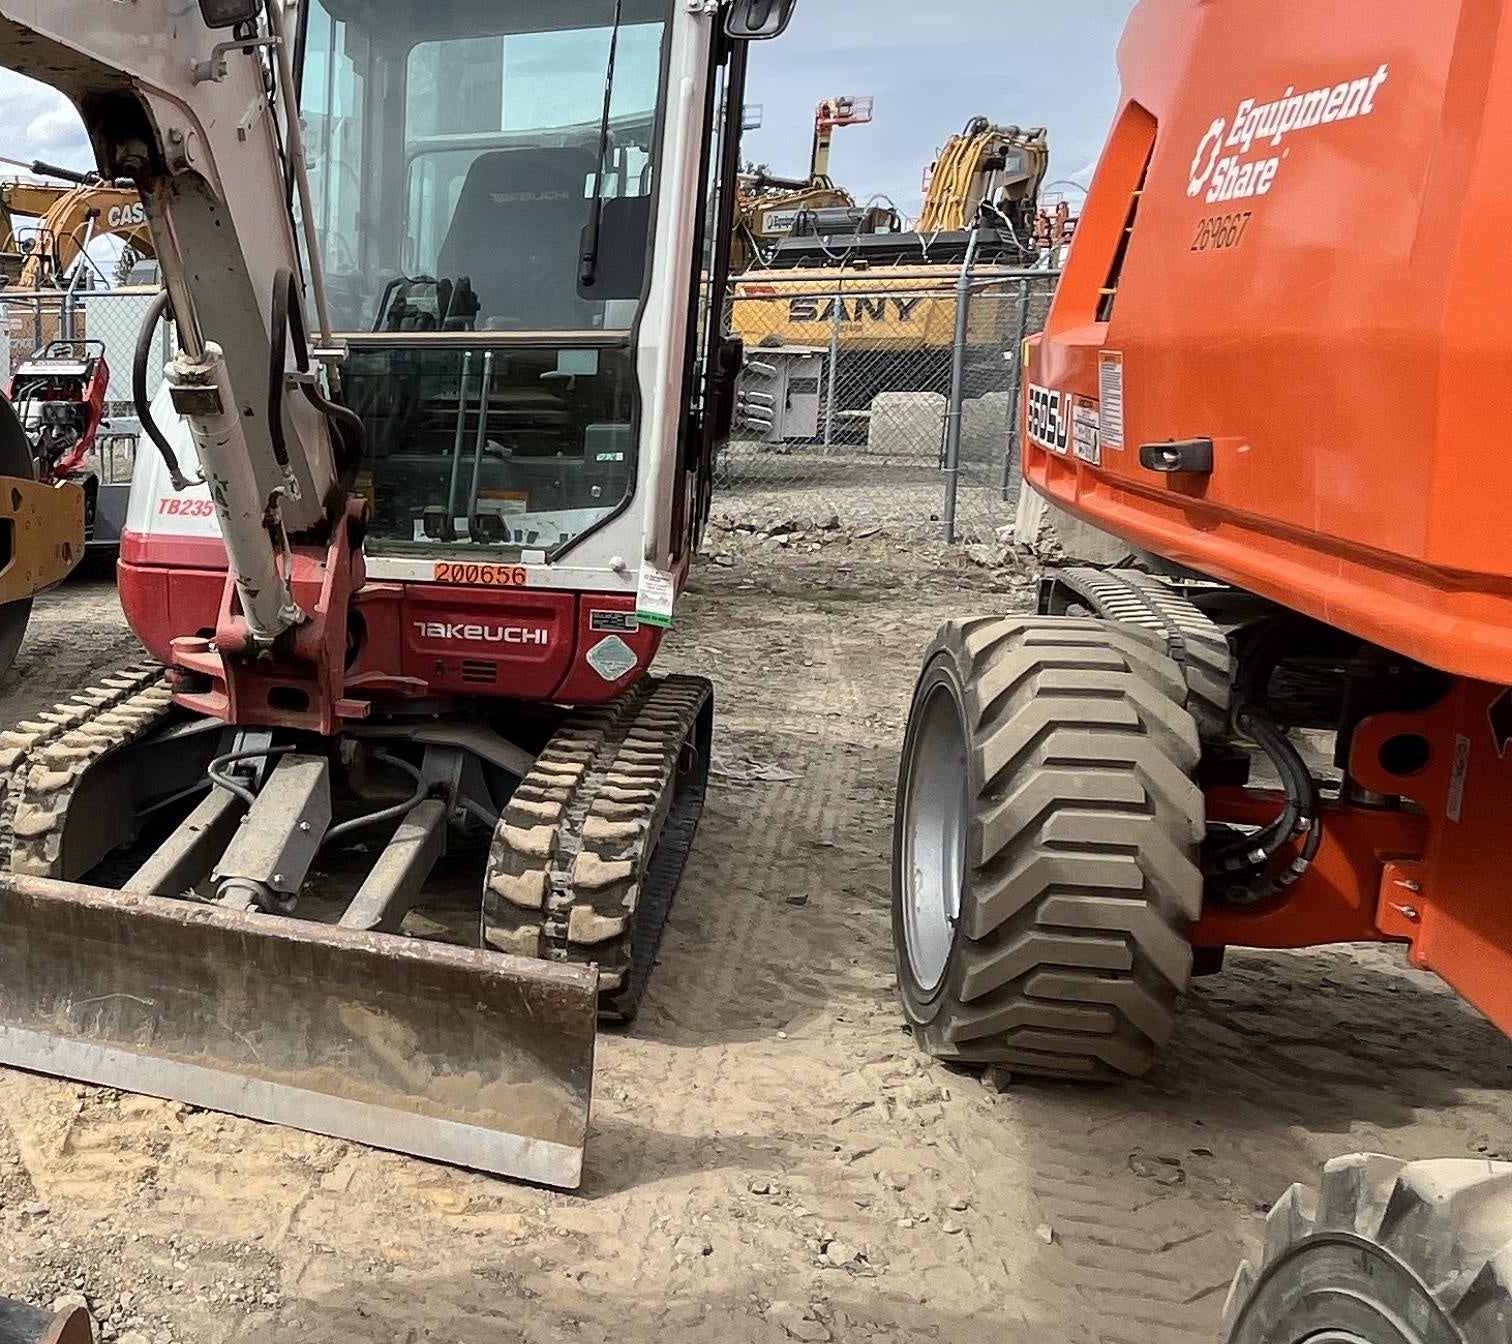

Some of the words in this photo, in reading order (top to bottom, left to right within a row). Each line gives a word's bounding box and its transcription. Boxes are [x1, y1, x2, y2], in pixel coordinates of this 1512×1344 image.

[1224, 64, 1388, 153] Equipment
[1205, 155, 1279, 203] Share
[108, 201, 147, 227] CAS
[789, 297, 922, 322] SANY
[437, 563, 527, 585] 200656
